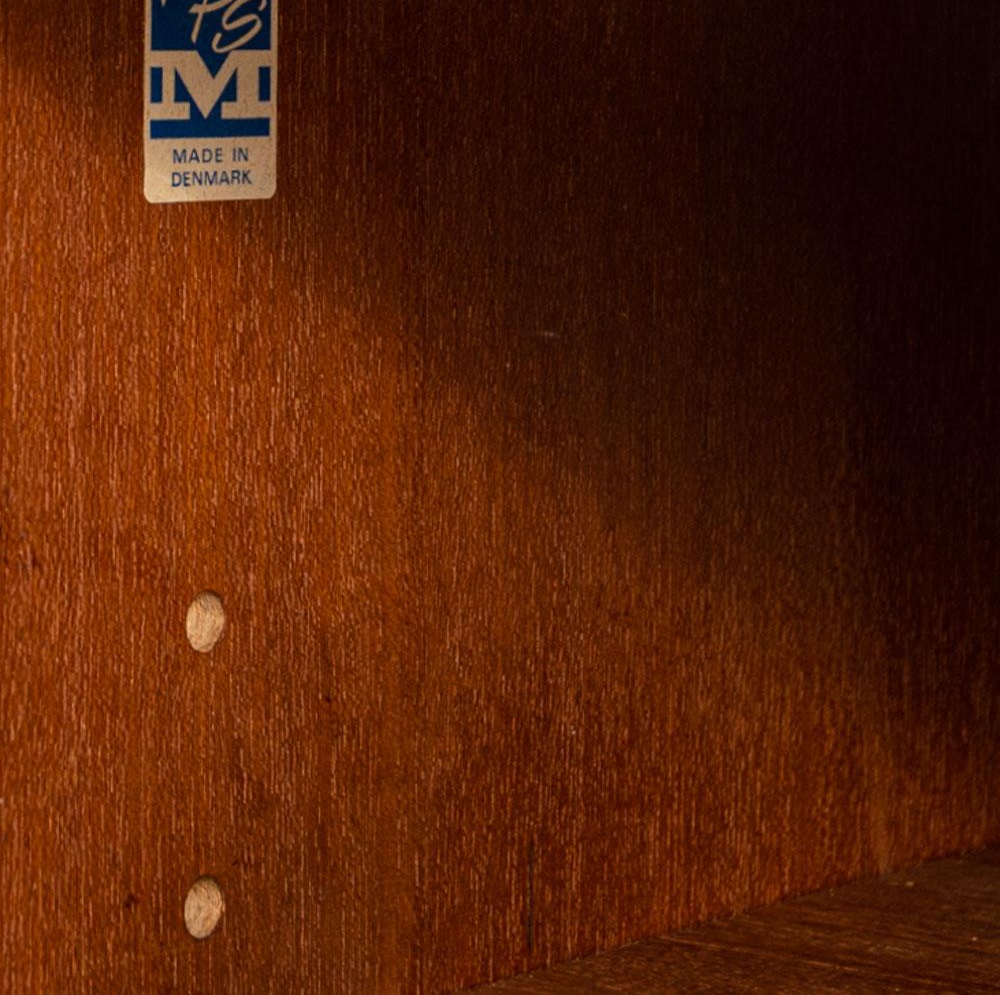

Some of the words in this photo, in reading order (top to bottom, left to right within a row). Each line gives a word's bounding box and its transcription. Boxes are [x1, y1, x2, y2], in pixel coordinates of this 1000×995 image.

[172, 148, 223, 164] MADE
[232, 147, 249, 162] IN
[171, 170, 252, 187] DENMARK
